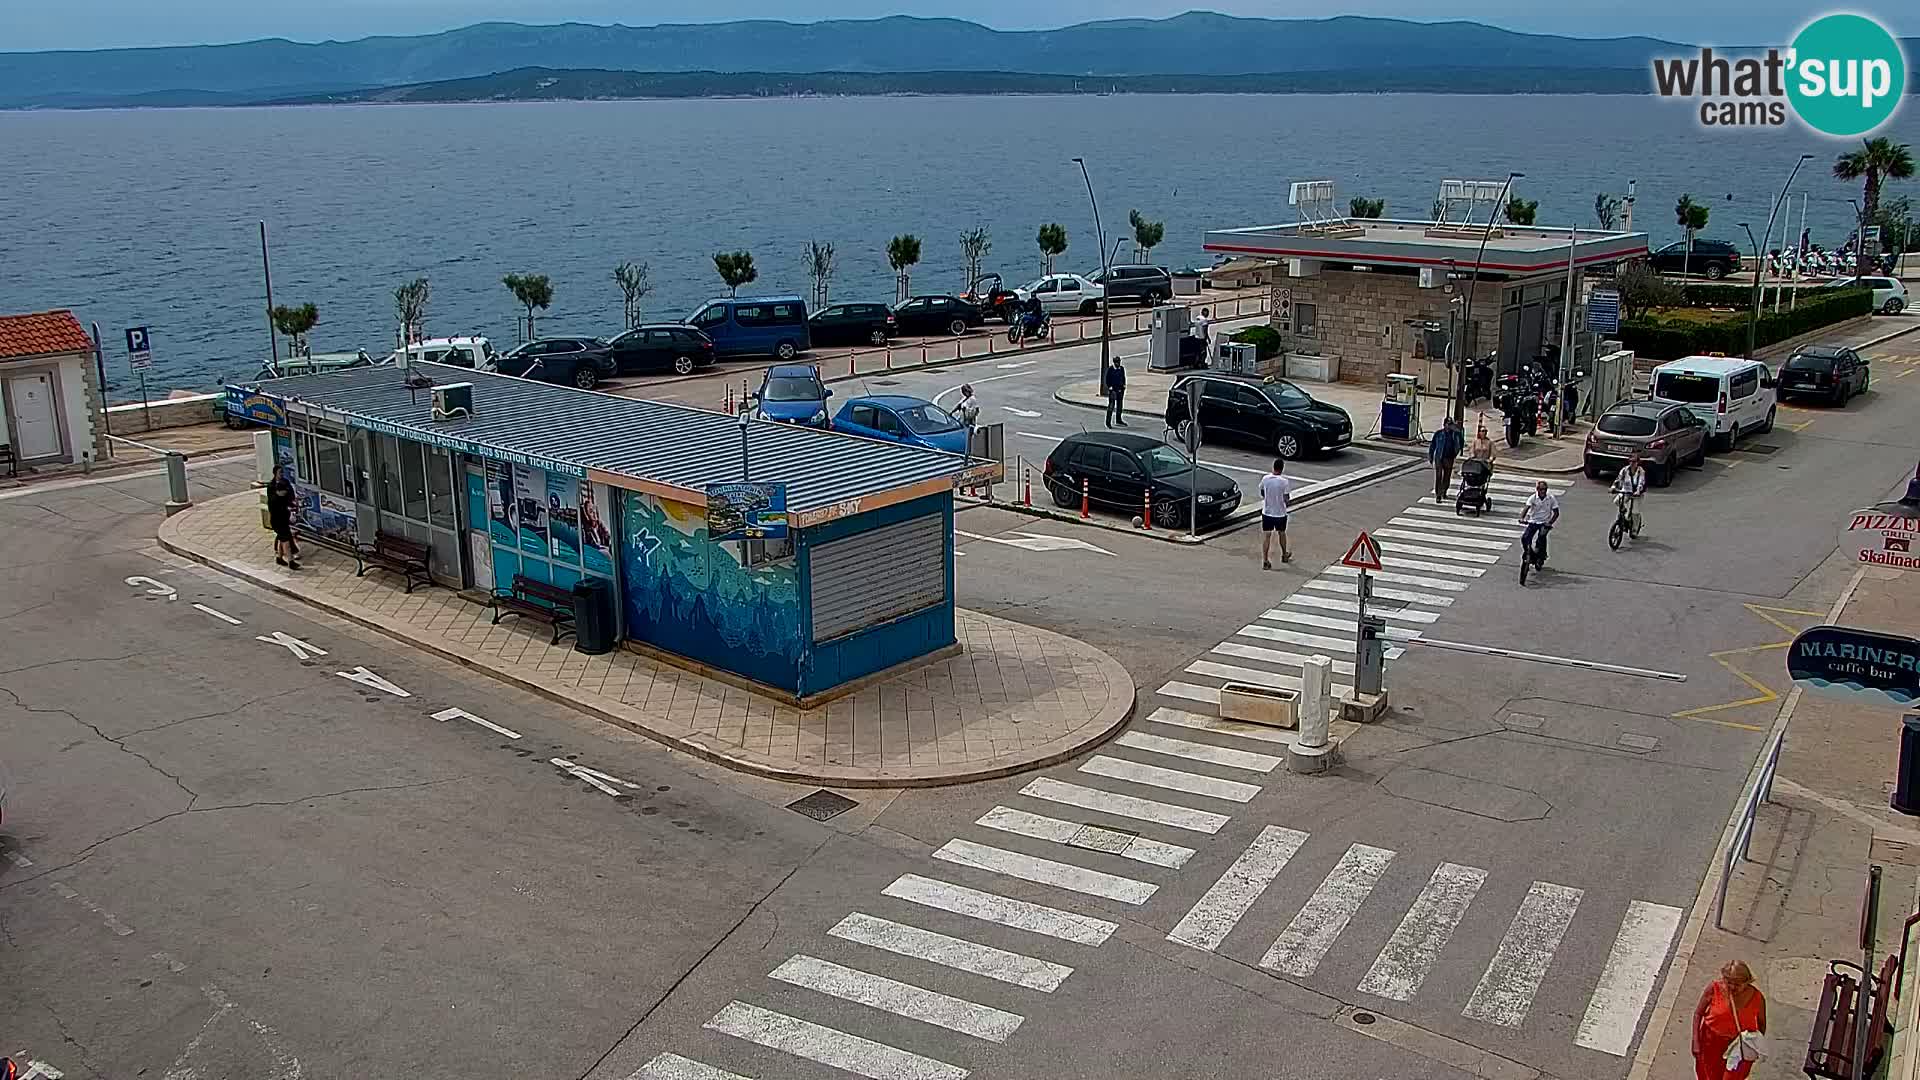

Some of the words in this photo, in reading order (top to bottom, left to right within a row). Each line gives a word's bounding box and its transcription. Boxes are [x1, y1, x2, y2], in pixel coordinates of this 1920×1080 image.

[131, 330, 143, 349] P
[397, 427, 437, 444] AUTOBUSNA
[437, 437, 469, 452] POSTAJA
[479, 447, 494, 457] BUS
[495, 449, 527, 464] STATION
[528, 456, 555, 470] TICKET
[556, 462, 583, 477] OFFICE
[1848, 514, 1920, 534] PIZZE
[1881, 530, 1916, 541] GRILL
[1828, 661, 1865, 675] caffe
[1870, 664, 1896, 680] bar
